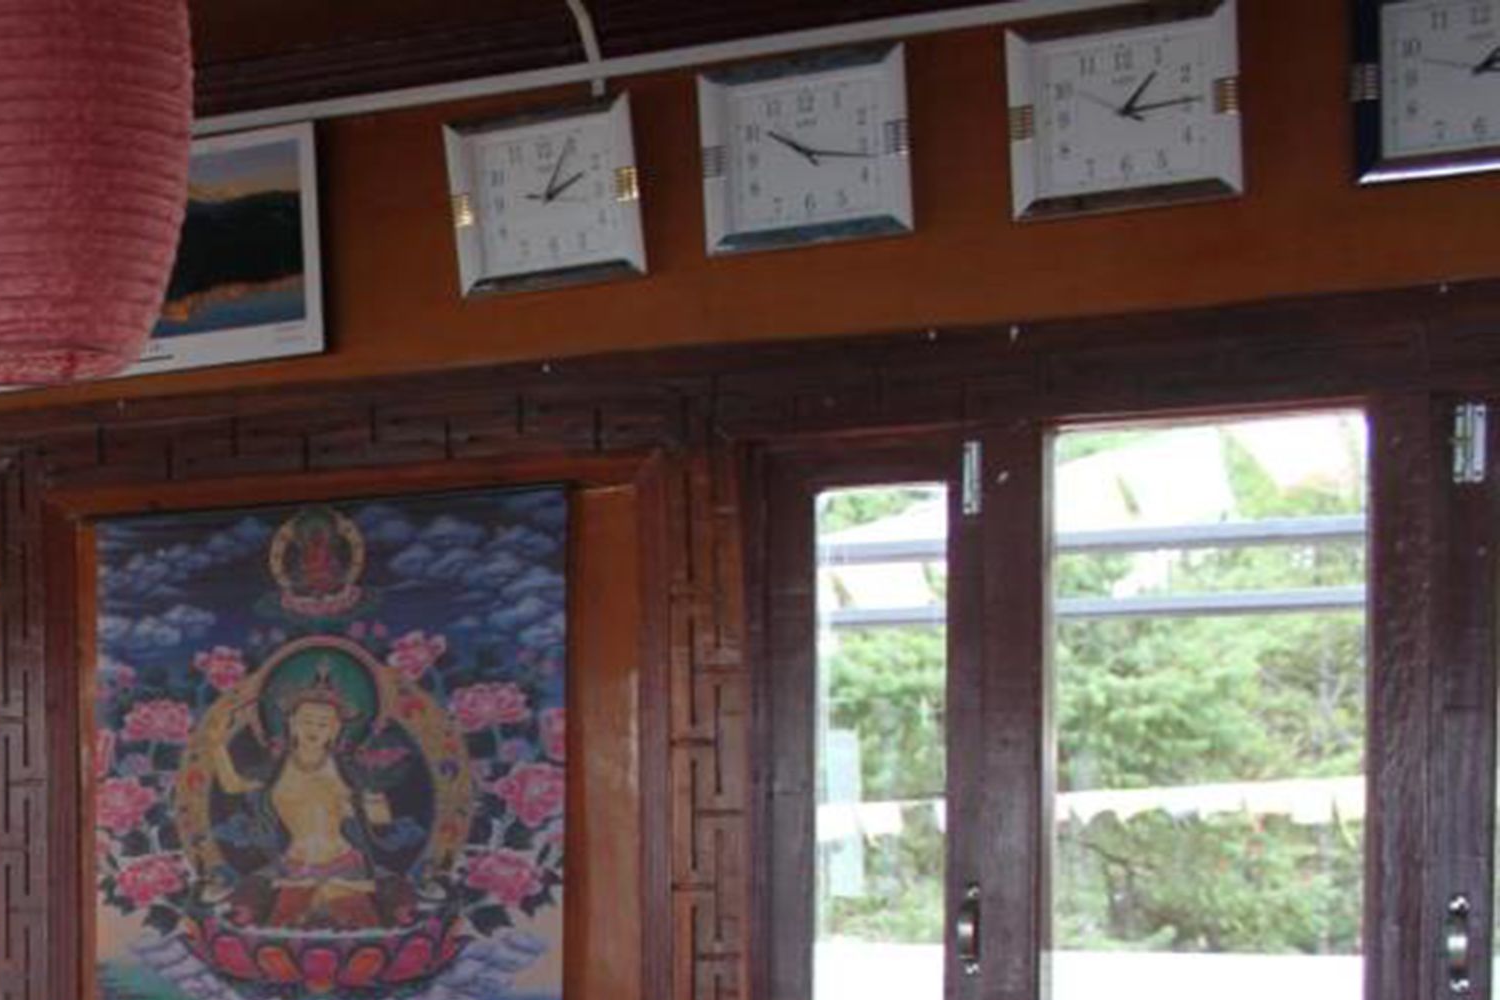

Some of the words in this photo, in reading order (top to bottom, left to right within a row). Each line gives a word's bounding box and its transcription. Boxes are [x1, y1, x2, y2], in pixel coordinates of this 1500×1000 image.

[1430, 10, 1448, 30] 11
[1470, 5, 1492, 25] 12
[1402, 38, 1422, 57] 10
[1078, 56, 1096, 77] 11
[1113, 48, 1134, 71] 12
[1180, 62, 1192, 84] 2
[1054, 82, 1073, 101] 10
[1120, 153, 1134, 174] 6
[804, 192, 817, 212] 6
